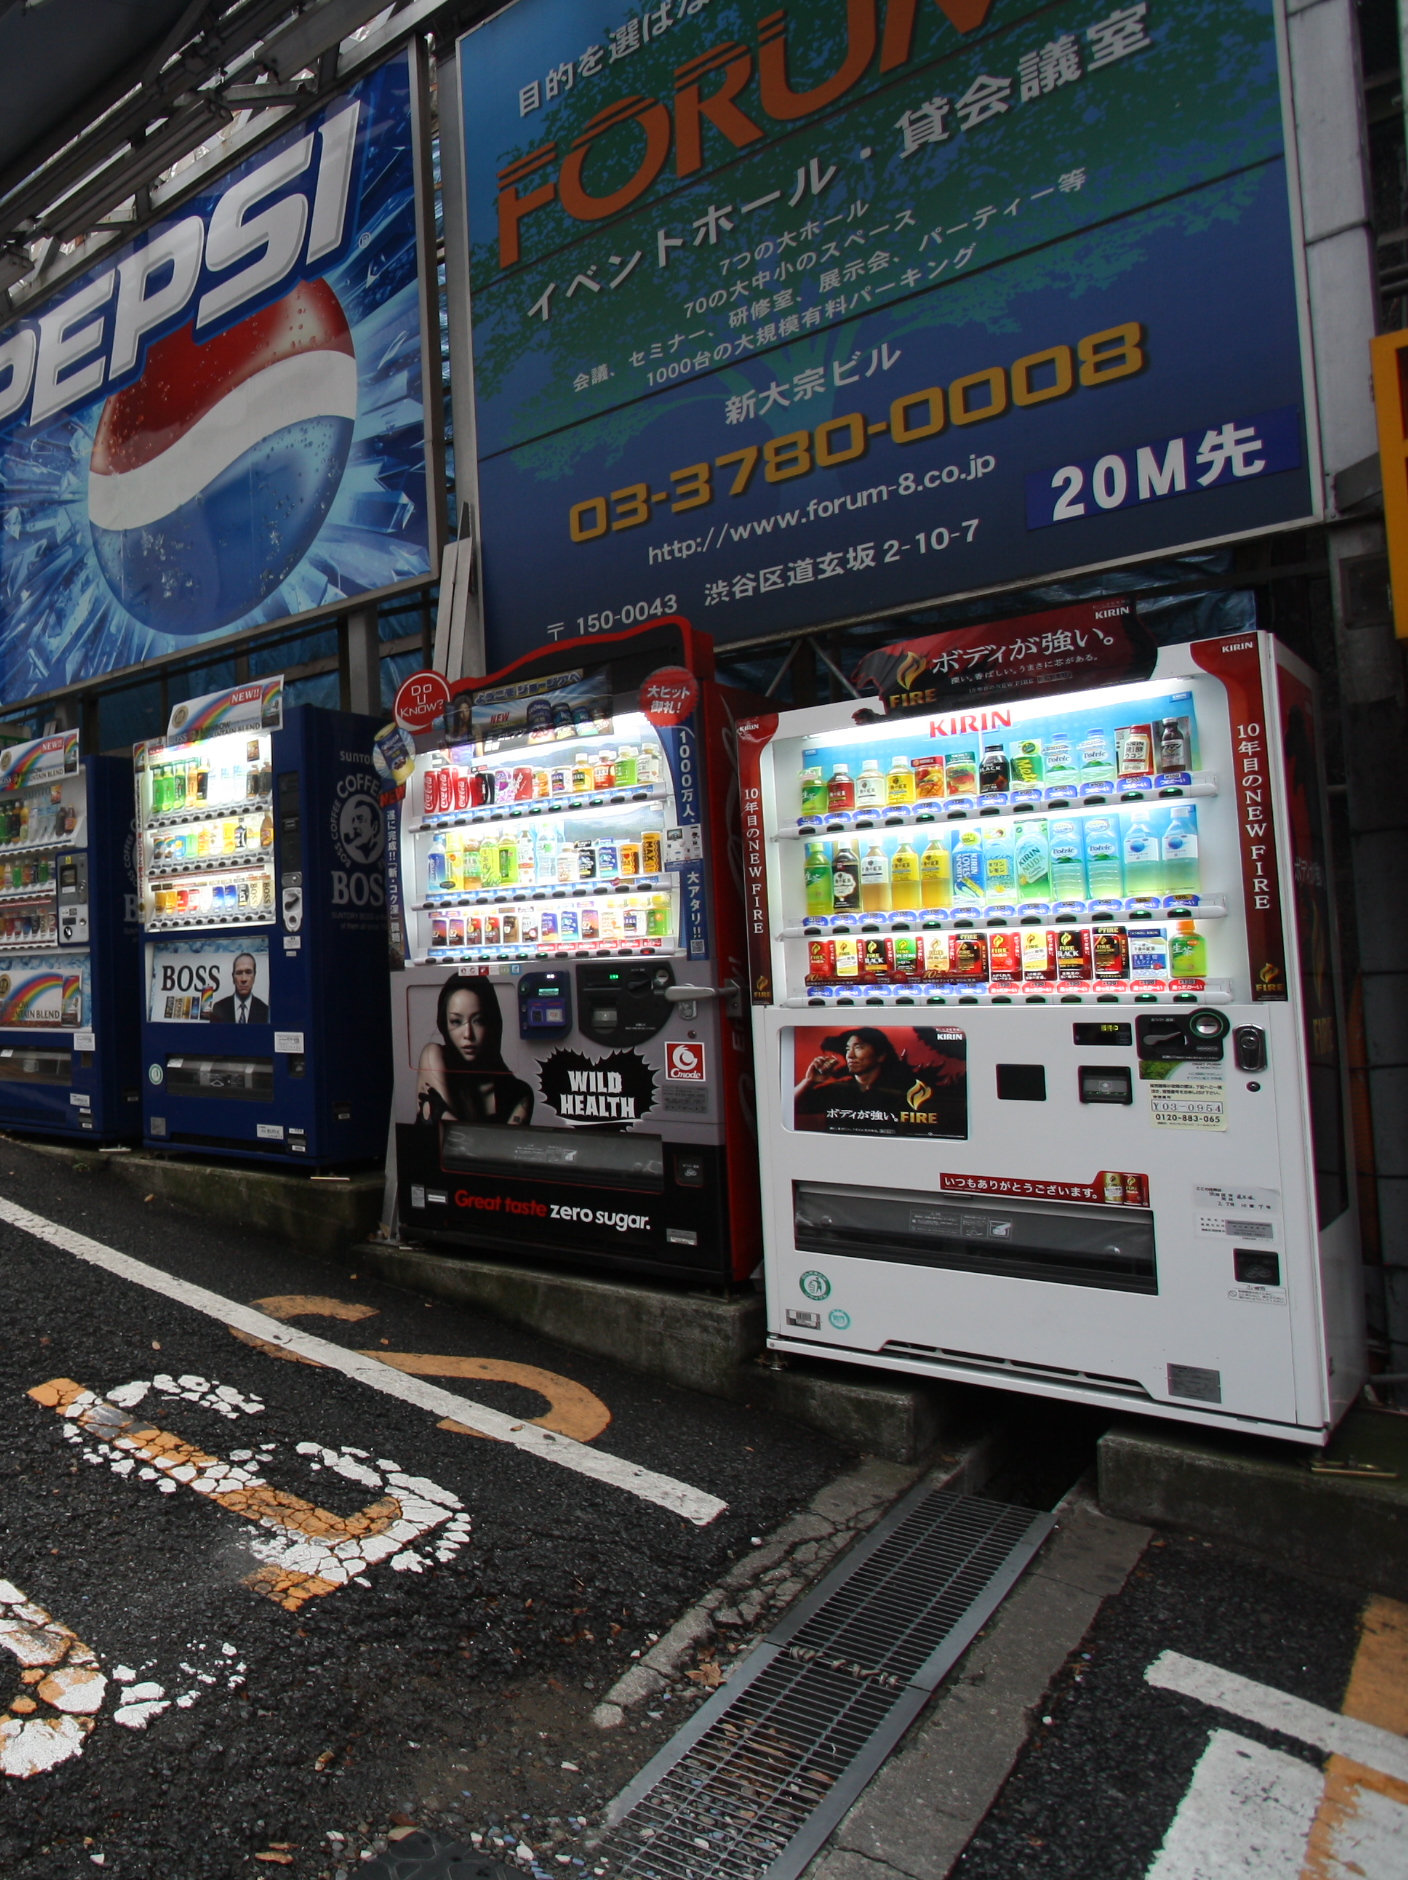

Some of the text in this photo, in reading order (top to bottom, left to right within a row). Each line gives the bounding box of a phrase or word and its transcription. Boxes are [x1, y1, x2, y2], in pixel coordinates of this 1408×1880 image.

[527, 2, 1152, 322] イベントホール・貸会議室
[719, 200, 869, 276] 7つの大ホール
[684, 208, 916, 319] 70の大中小のスペース
[646, 243, 977, 387] 1000台の大規模有料パーキング
[725, 343, 902, 426] 新大宗ビル
[569, 321, 1145, 543] 03-3780-0008
[1052, 423, 1267, 522] 20M先
[648, 454, 996, 565] http://www.forum-8.co.jp
[576, 594, 678, 635] 150-0043
[704, 542, 876, 607] 渋谷区道玄坂
[884, 519, 981, 563] 2-10-7
[1094, 606, 1130, 620] KIRIN
[932, 628, 1114, 674] ボディが強い。
[1221, 641, 1254, 654] KIRIN
[231, 688, 260, 704] NEW!!
[411, 684, 432, 697] DO
[417, 694, 426, 705] U
[647, 685, 690, 699] 大ヒット
[890, 688, 936, 707] FIRE
[400, 699, 444, 718] KNOW?
[490, 712, 510, 724] NEW
[240, 722, 261, 733] BLEND
[739, 723, 760, 732] KIRIN
[929, 709, 1013, 739] KIRIN
[340, 751, 375, 765] SUNTO
[47, 768, 64, 779] BLEND
[337, 773, 382, 798] COFFE
[380, 784, 406, 807] NEW
[1236, 723, 1270, 911] 10年目のNEW FIRE
[645, 841, 653, 862] MAX
[1018, 847, 1041, 867] KIRIN
[955, 853, 963, 883] SPORTS
[963, 853, 971, 878] LOVES
[1021, 855, 1046, 873] NUDA
[331, 871, 387, 907] BOS
[752, 883, 764, 934] FIRE
[1172, 944, 1193, 956] 生茶
[161, 964, 221, 993] BOSS
[1255, 983, 1284, 992] FIRE
[36, 1010, 60, 1020] BLEND
[936, 1033, 963, 1041] KIRIN
[567, 1070, 623, 1093] WILD
[670, 1068, 701, 1079] Cmode
[560, 1093, 635, 1118] HEALTH
[826, 1108, 899, 1123] ボディが強い。
[1153, 1101, 1222, 1113] Y03-0954
[900, 1111, 939, 1124] FIRE
[1155, 1113, 1221, 1123] 0120-883-065
[944, 1176, 1098, 1200] いつもありがとうございます。
[454, 1190, 651, 1231] Great taste zero sugar.
